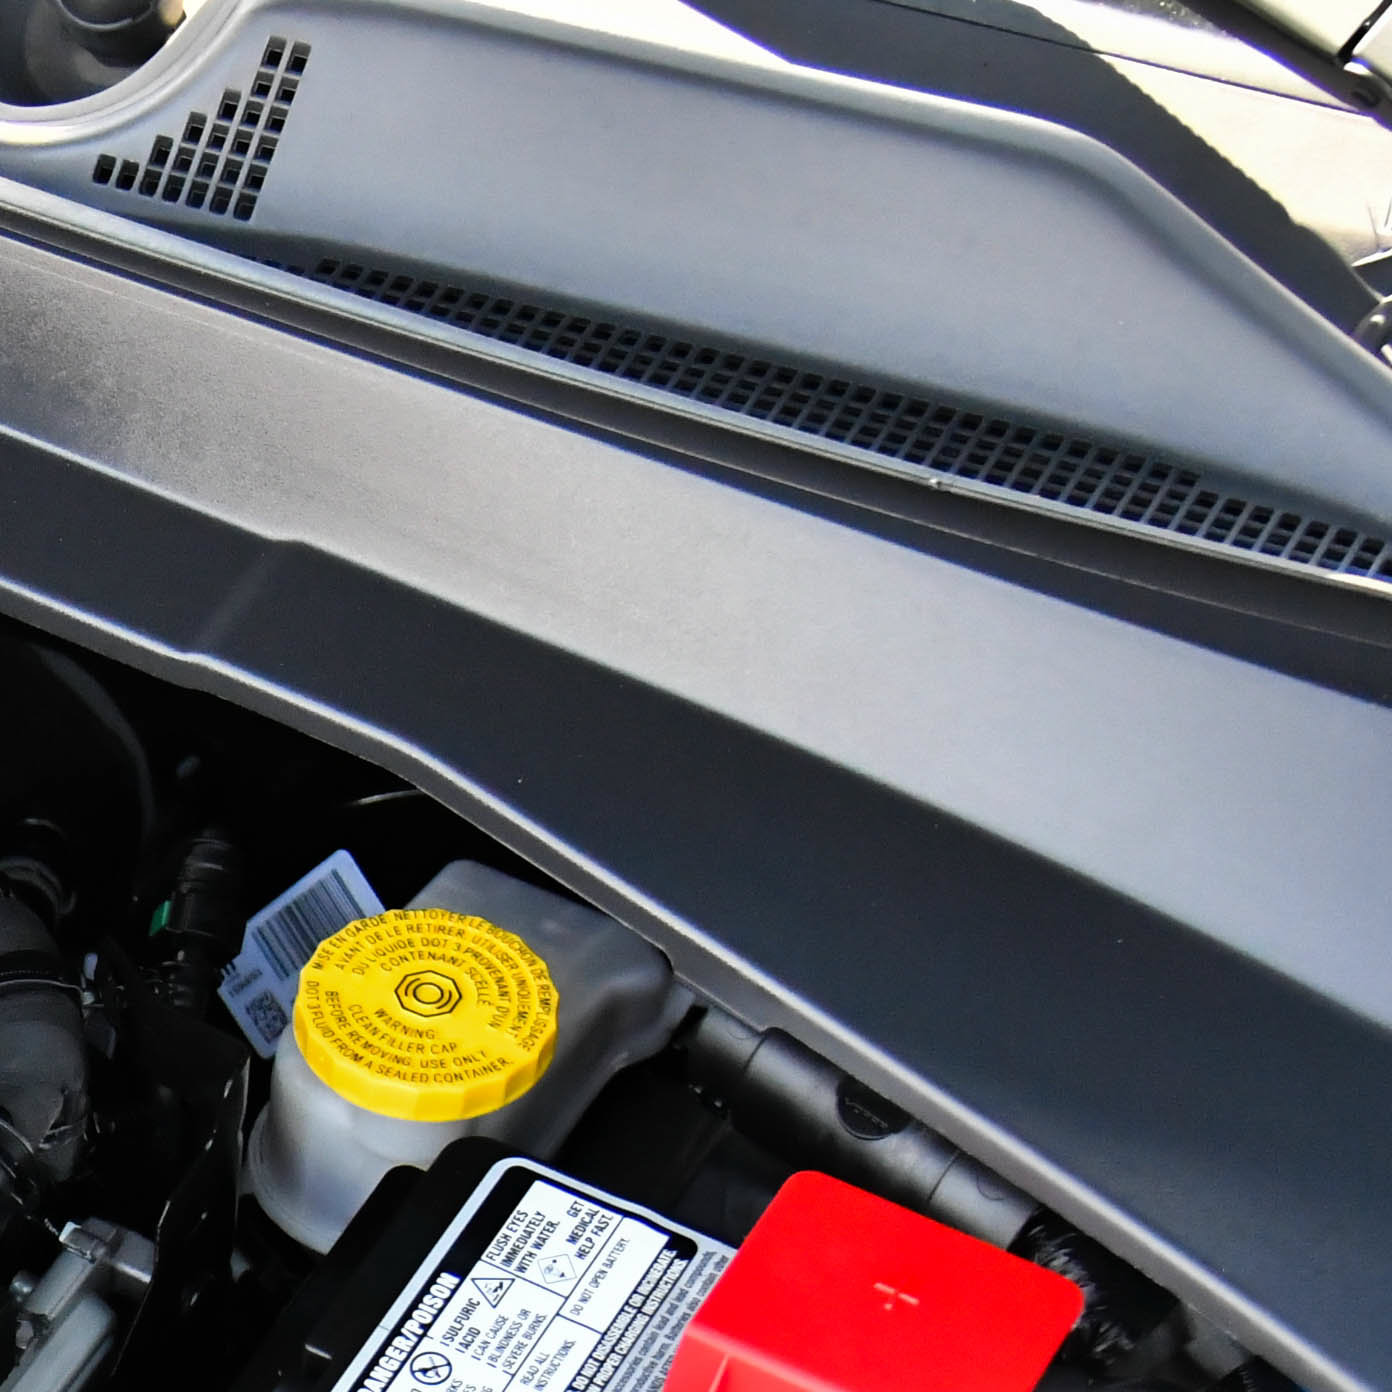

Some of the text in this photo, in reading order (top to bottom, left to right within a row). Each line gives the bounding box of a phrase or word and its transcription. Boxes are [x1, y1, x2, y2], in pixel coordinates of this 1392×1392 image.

[329, 934, 346, 950] EN
[335, 941, 364, 971] AVANT
[365, 931, 384, 945] DE
[385, 926, 401, 937] LE
[352, 960, 369, 976] DU
[365, 938, 416, 963] LIQUIDE
[421, 937, 448, 947] DOT
[452, 942, 462, 952] 3
[380, 951, 467, 972] CONTENANT
[305, 980, 320, 1000] DOT
[330, 1038, 364, 1062] FROM
[364, 1060, 373, 1070] A
[376, 1064, 429, 1083] SEALED
[325, 990, 351, 1030] BEFORE
[420, 1059, 446, 1069] USE
[453, 1050, 487, 1067] ONLY
[348, 1004, 457, 1054] CLEAN FILLER CAP
[565, 1200, 585, 1218] GET
[565, 1206, 600, 1245] MEDICAL
[484, 1209, 528, 1261] FLUSH EYES
[499, 1210, 547, 1268] IMMEDIATELY
[513, 1217, 560, 1274] WITH WATER.
[573, 1235, 598, 1260] HELP
[568, 1303, 584, 1315] DO
[576, 1288, 595, 1304] NOT
[587, 1268, 609, 1289] OPEN
[626, 1292, 646, 1307] OR
[651, 1314, 670, 1331] lead
[671, 1287, 689, 1303] lead
[441, 1296, 481, 1342] SULFURIC
[457, 1326, 482, 1349] ACID
[472, 1313, 510, 1357] CAN CAUSE
[486, 1307, 532, 1363] BLINDNESS OR
[590, 1304, 638, 1360] DISASSEMBLE
[500, 1339, 528, 1369] SEVERE
[518, 1351, 550, 1386] READ ALL
[578, 1357, 601, 1377] NOT
[591, 1351, 624, 1386] PROPER
[612, 1312, 651, 1354] CHARGING
[569, 1374, 589, 1390] DO
